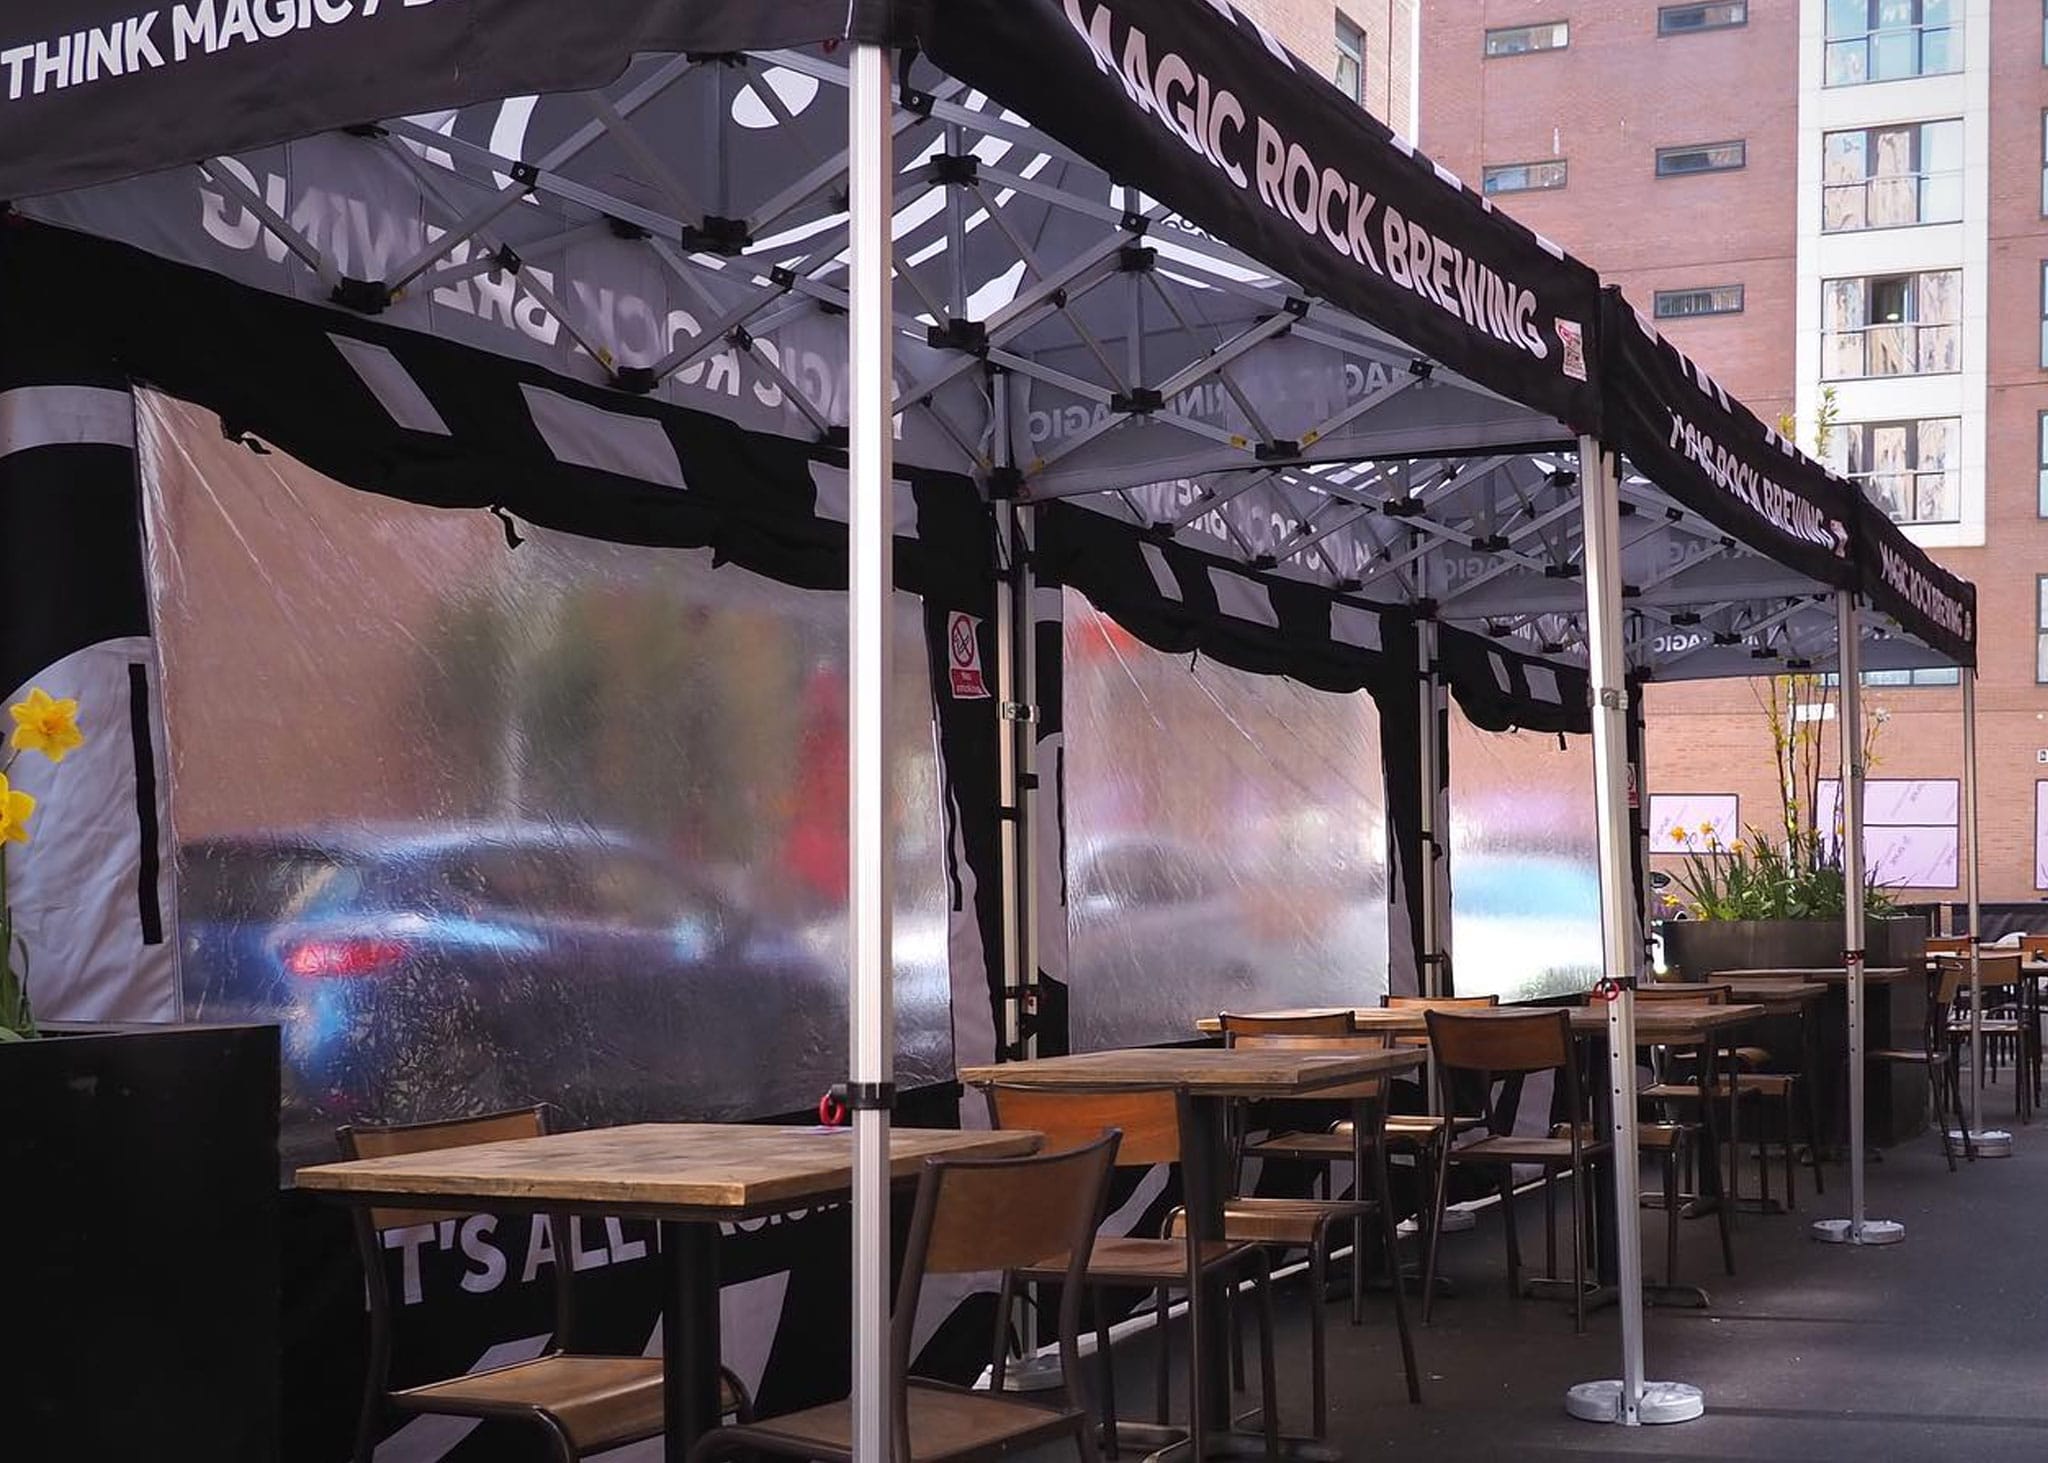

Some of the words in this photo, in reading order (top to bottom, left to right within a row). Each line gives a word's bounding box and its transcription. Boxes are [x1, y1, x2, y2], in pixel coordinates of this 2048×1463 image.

[0, 10, 166, 100] THINK
[1256, 115, 1383, 276] ROCK
[1382, 204, 1549, 360] BREWING
[365, 1212, 508, 1312] T'S
[520, 1212, 648, 1283] ALL
